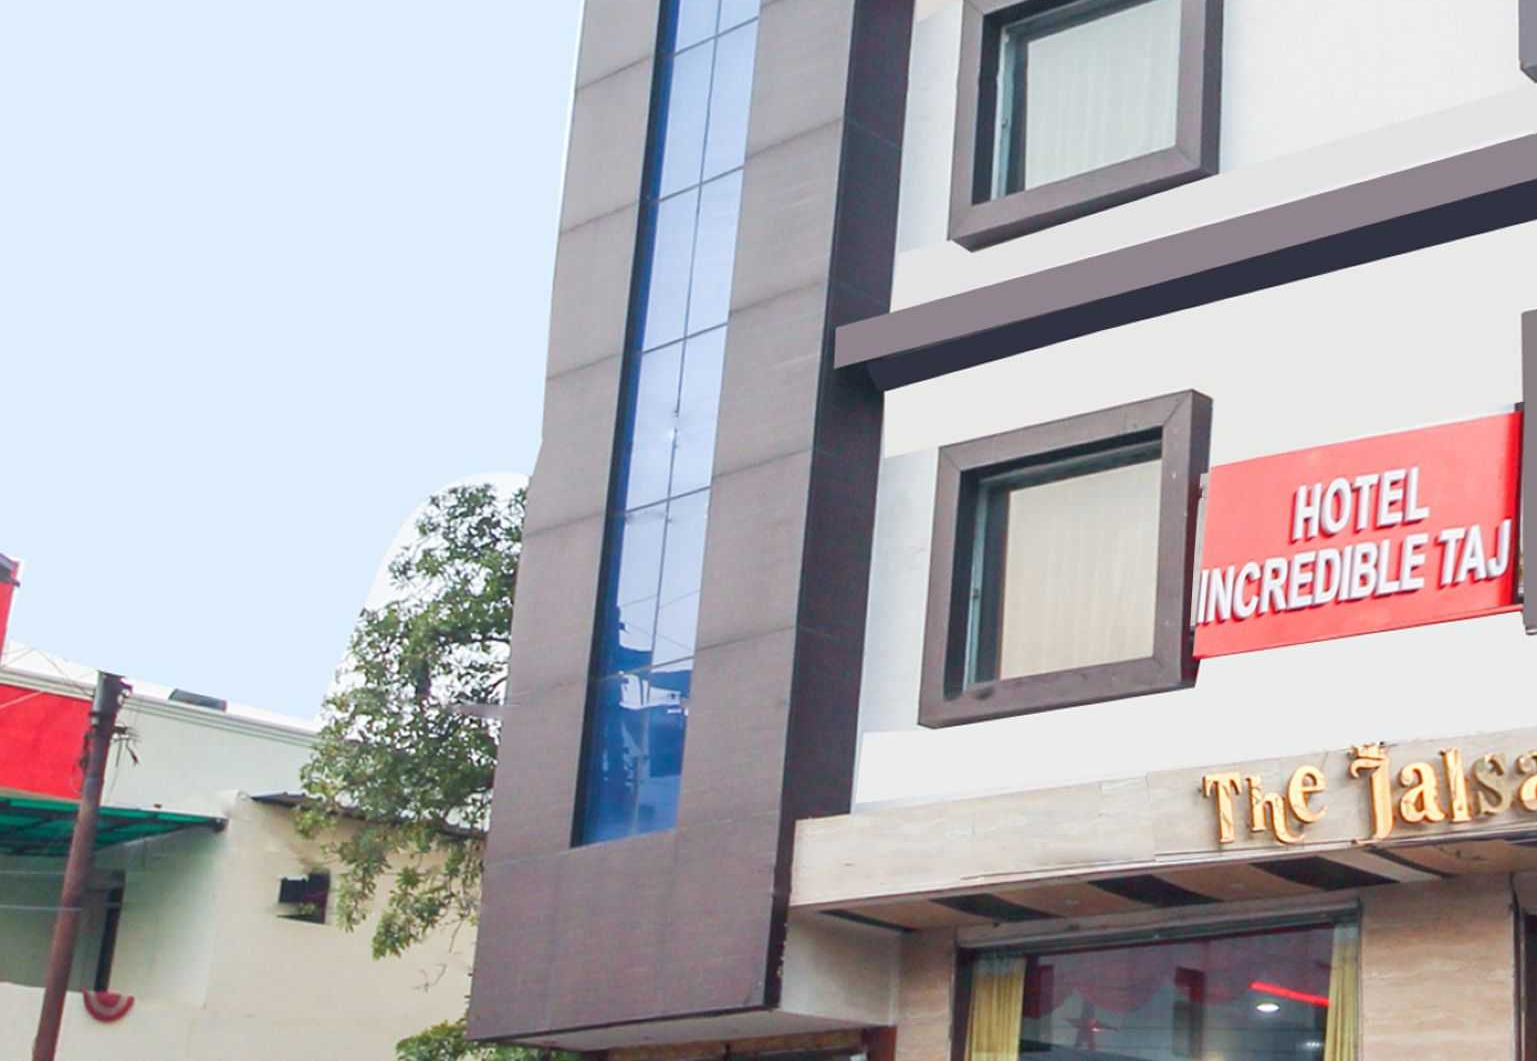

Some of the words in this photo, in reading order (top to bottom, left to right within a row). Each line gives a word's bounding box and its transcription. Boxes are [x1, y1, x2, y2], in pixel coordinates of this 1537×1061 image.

[1292, 466, 1431, 541] HOTEL
[1196, 533, 1429, 625] INCREDIBLE
[1438, 519, 1513, 588] TAJ
[1202, 764, 1329, 845] The
